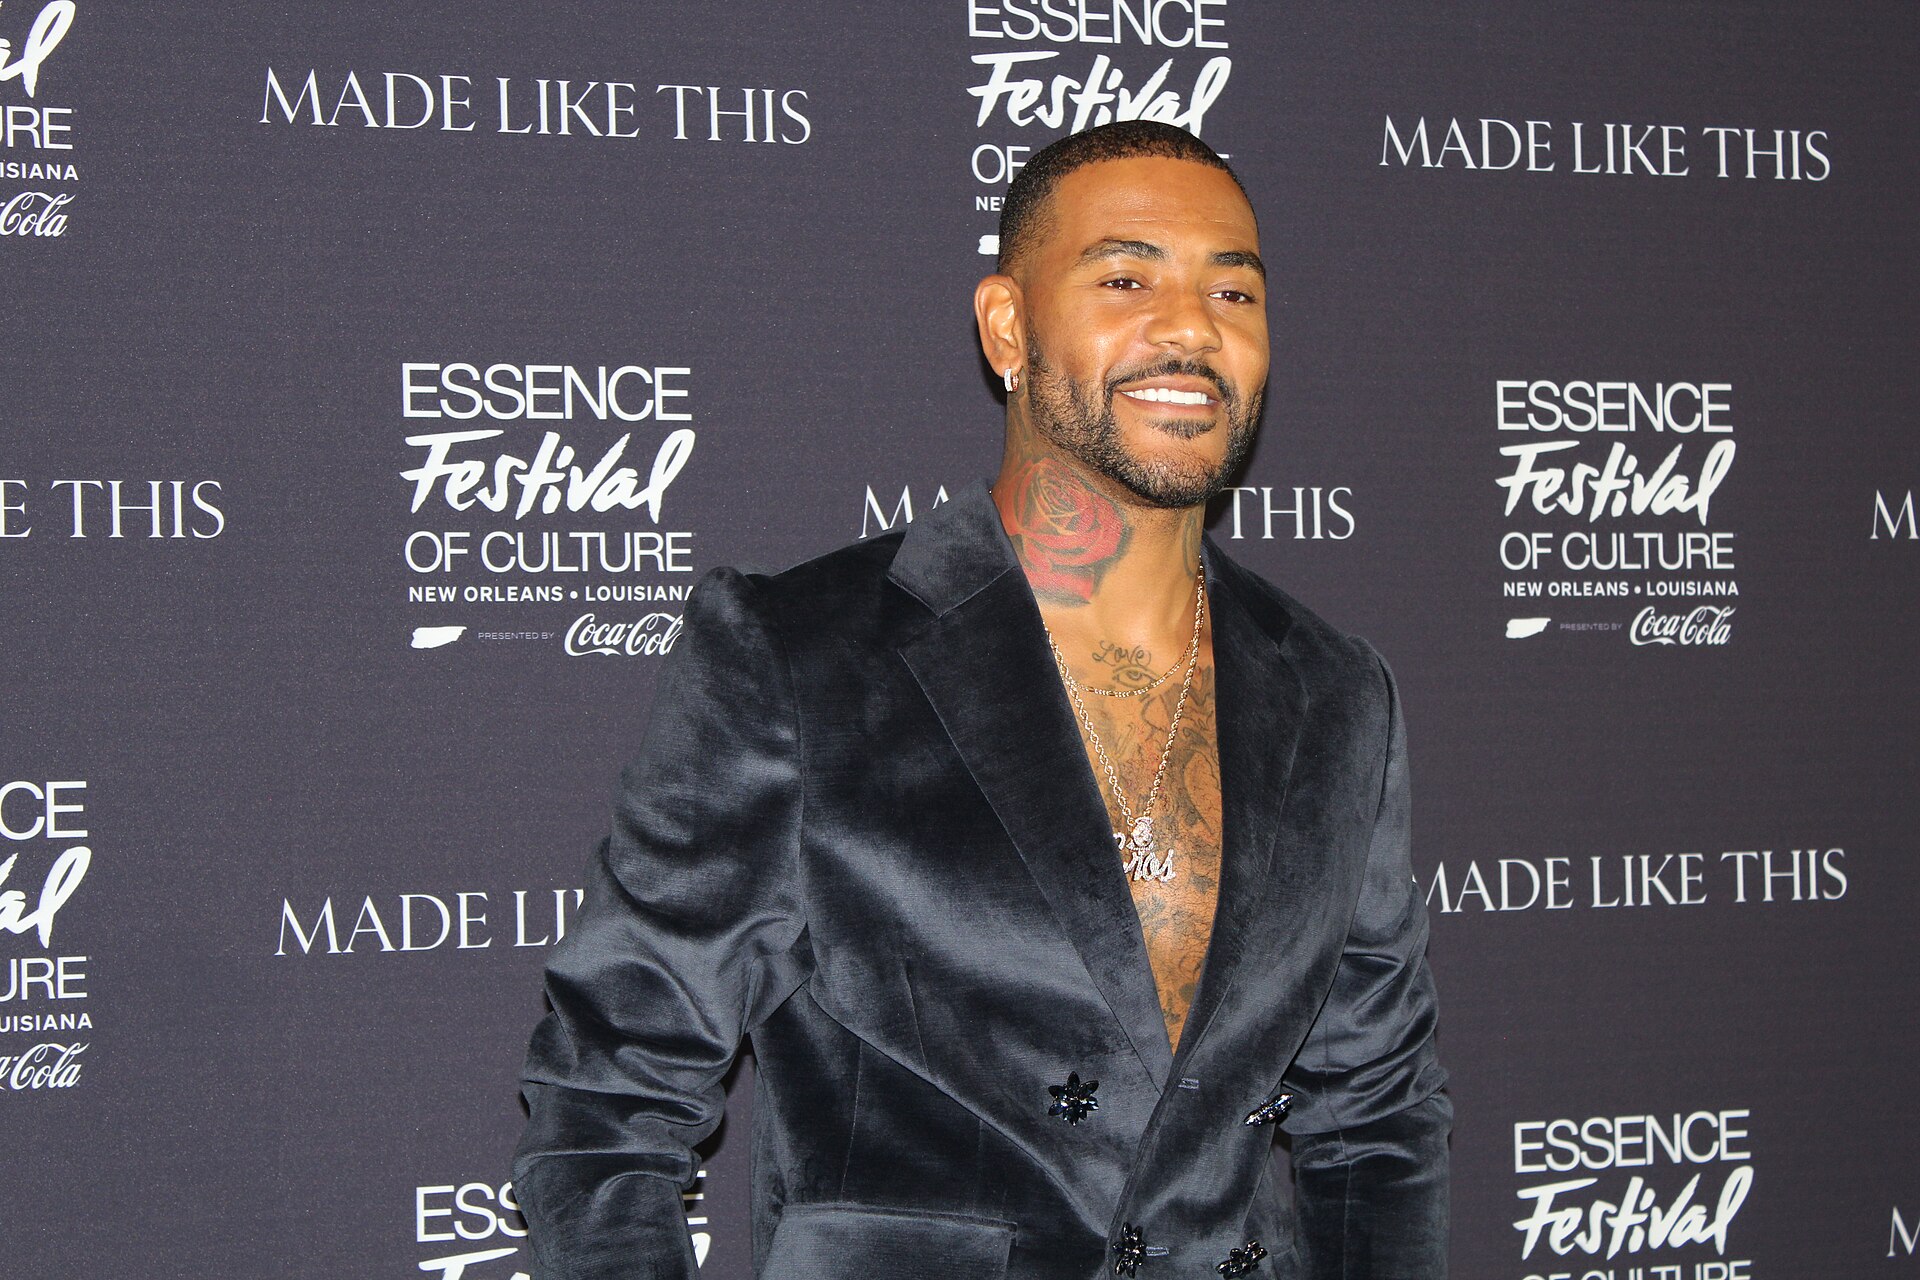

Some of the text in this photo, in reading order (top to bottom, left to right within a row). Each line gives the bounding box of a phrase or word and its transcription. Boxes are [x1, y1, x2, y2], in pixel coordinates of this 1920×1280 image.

[968, 0, 1228, 48] ESSENCE
[259, 66, 811, 145] MADE LIKE THIS
[966, 51, 1231, 139] Festival
[972, 144, 1030, 183] OF
[1379, 114, 1830, 181] MADE LIKE THIS
[975, 196, 1005, 211] NE
[403, 363, 692, 421] ESSENCE
[1497, 380, 1734, 433] ESSENCE
[400, 429, 695, 524] Festival
[1495, 439, 1737, 525] Festival
[50, 480, 225, 539] THIS
[1219, 486, 1355, 540] THIS
[405, 531, 693, 572] OF CULTURE
[1500, 532, 1735, 571] OF CULTURE
[409, 586, 457, 602] NEW
[464, 585, 564, 603] ORLEANS
[1503, 580, 1739, 597] NEW ORLEANS LOUISIANA
[478, 631, 555, 640] PRESENTED BY
[564, 613, 684, 656] Coca-Col
[1559, 622, 1623, 631] PRESENTED BY
[1629, 605, 1736, 646] Coca-Cola
[1591, 853, 1707, 908] LIKE
[1720, 848, 1848, 902] THIS
[274, 891, 492, 956] MADE
[1514, 1109, 1751, 1173] ESSENCE
[1513, 1166, 1754, 1260] Festival
